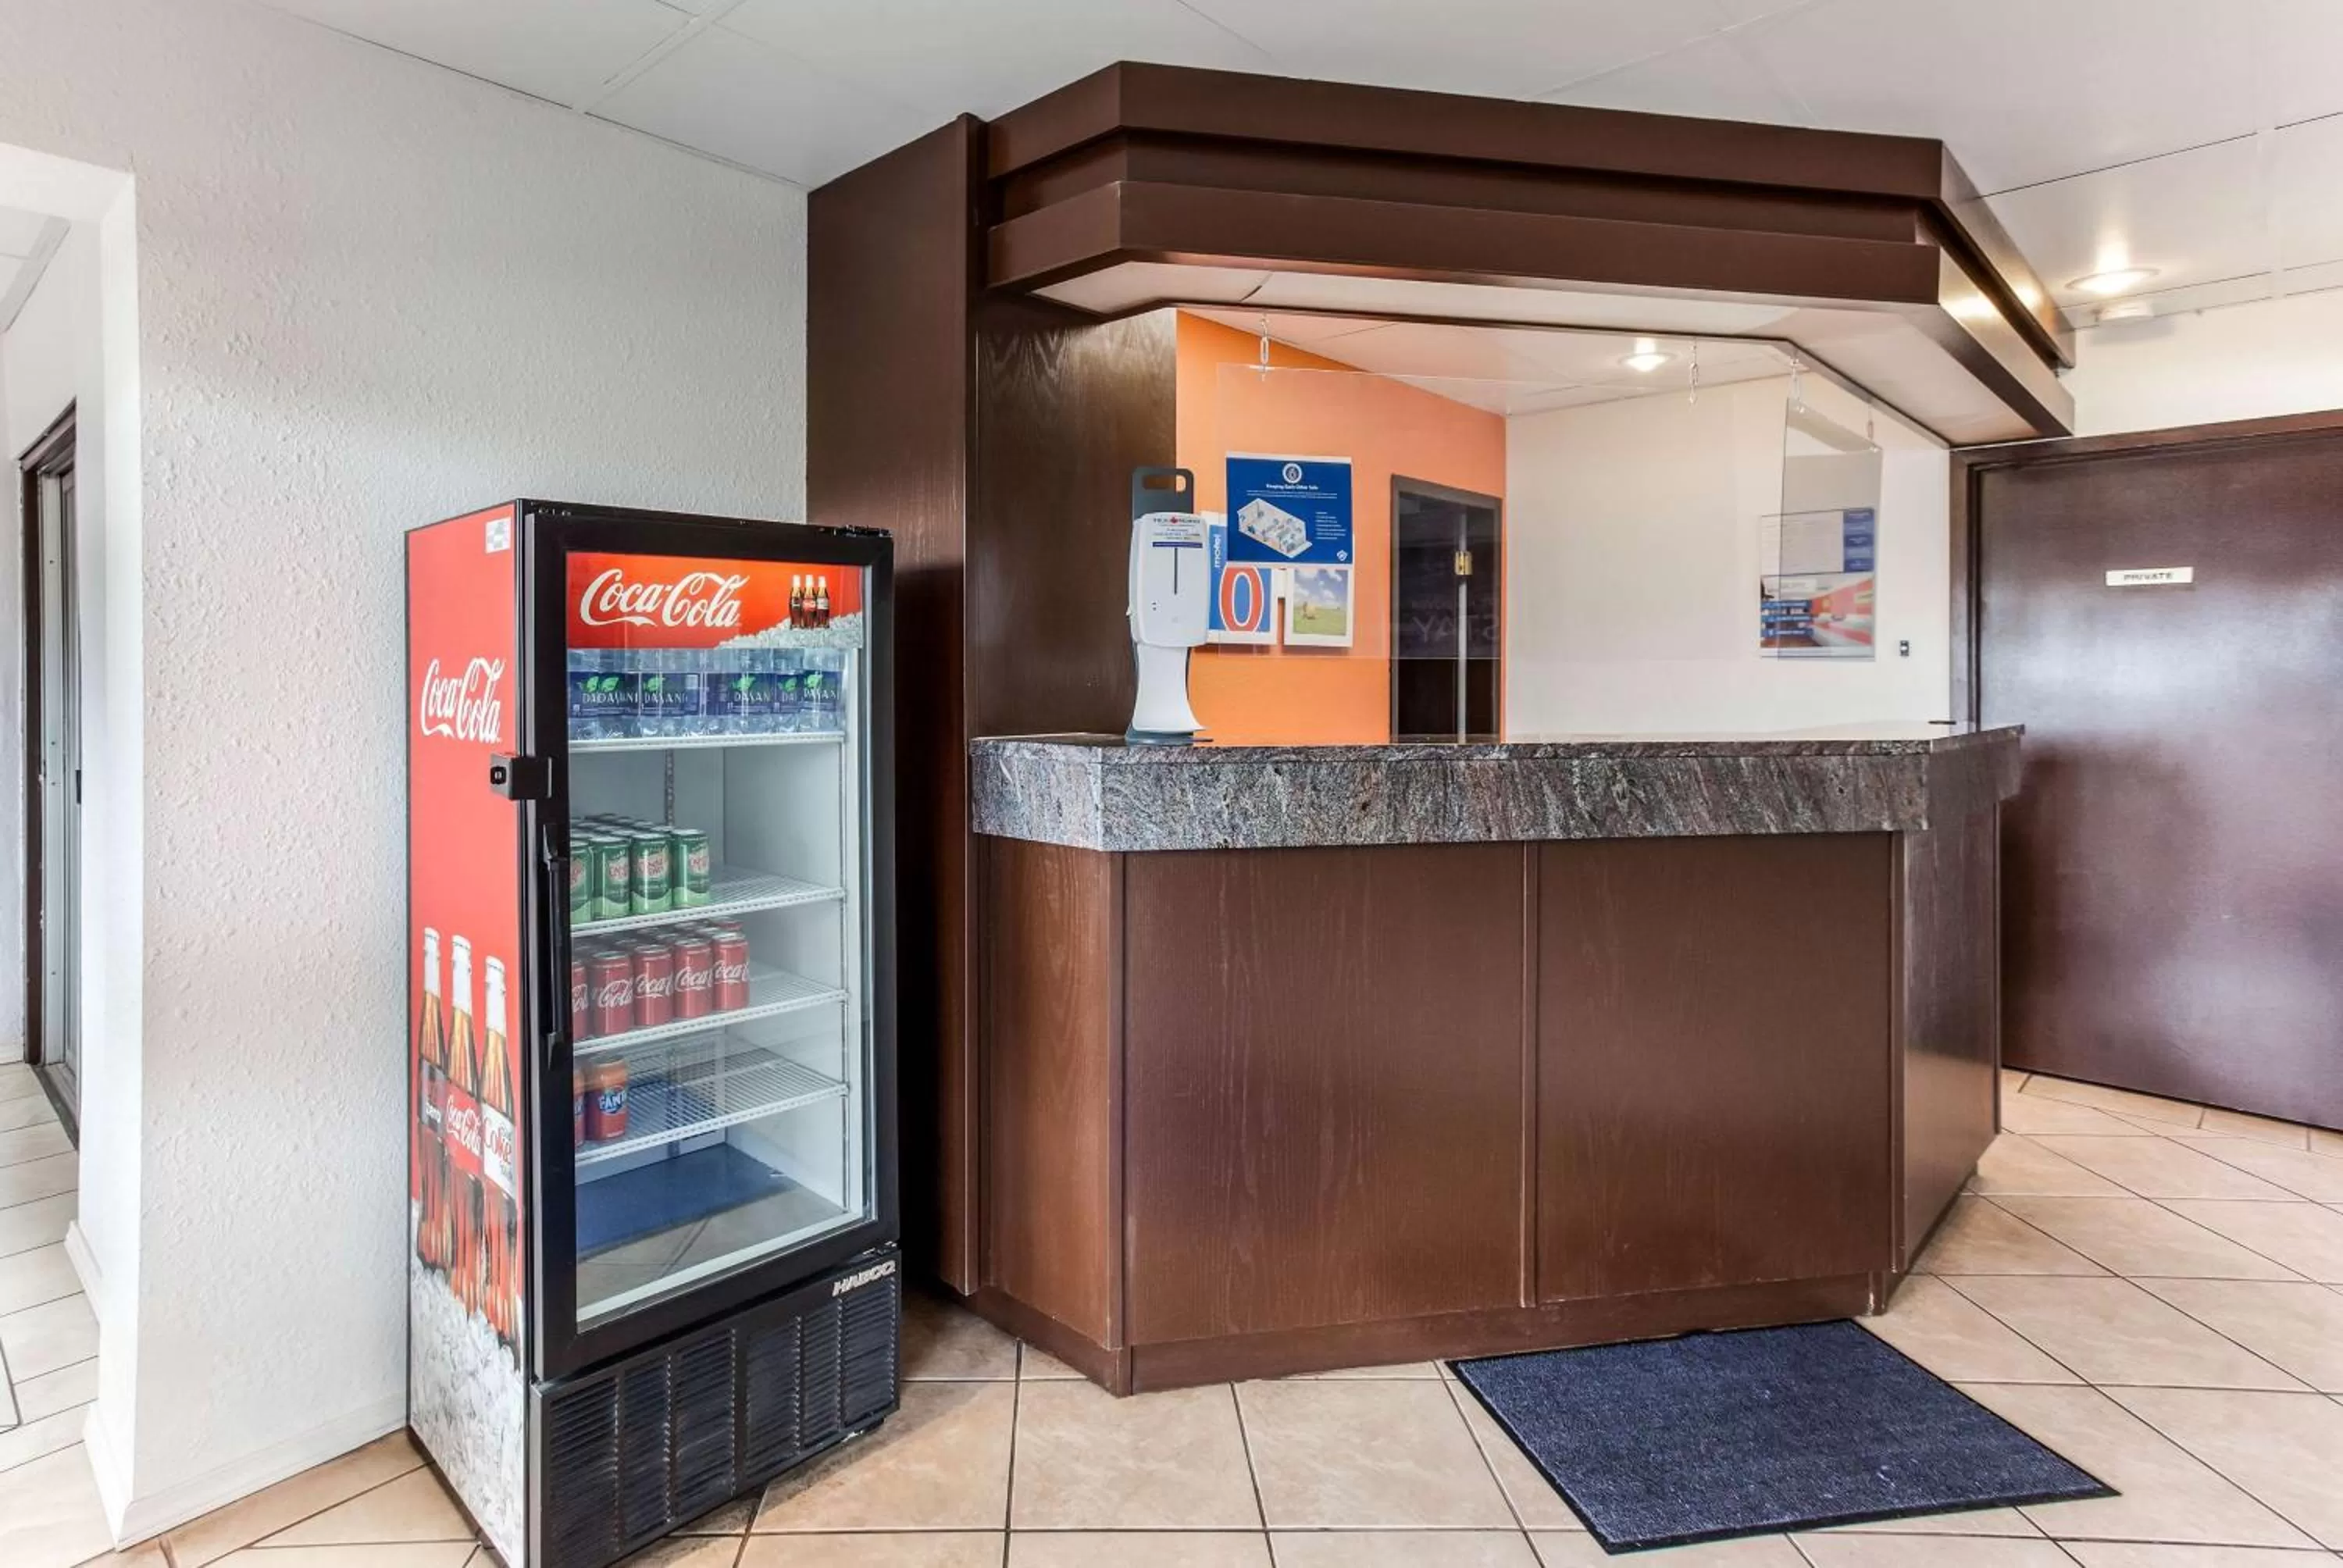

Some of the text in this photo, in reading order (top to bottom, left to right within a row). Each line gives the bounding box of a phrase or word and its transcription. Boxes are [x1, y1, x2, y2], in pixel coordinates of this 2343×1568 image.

[1214, 533, 1222, 568] motel
[580, 568, 750, 627] Coca-Cola
[420, 657, 506, 743] Coca-Cola
[831, 1260, 897, 1297] HABCO
